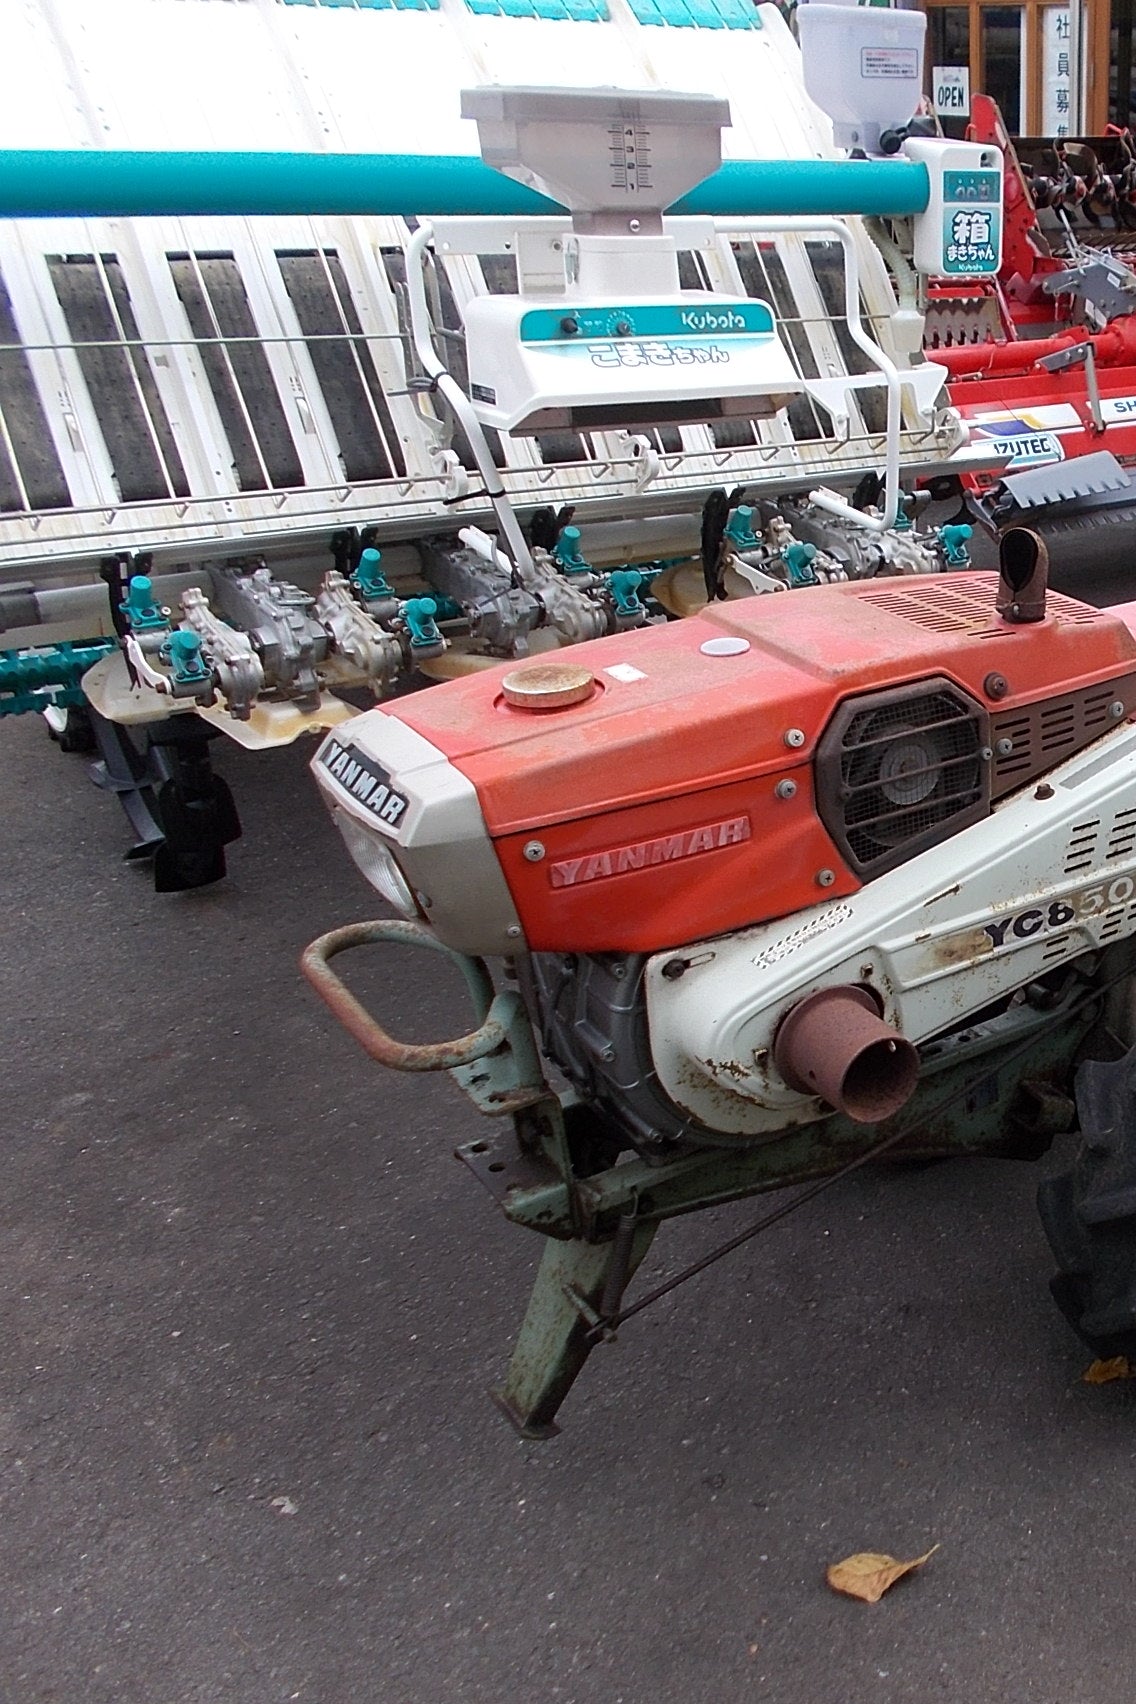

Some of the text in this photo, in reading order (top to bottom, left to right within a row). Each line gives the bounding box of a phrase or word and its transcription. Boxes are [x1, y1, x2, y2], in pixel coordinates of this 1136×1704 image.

[937, 86, 965, 108] OPEN
[952, 211, 991, 244] 箱
[947, 244, 995, 261] まきちゃん
[682, 310, 746, 330] Kubota
[588, 341, 730, 368] こまきちゃん
[324, 742, 406, 824] YANMAR
[554, 819, 746, 885] YANMAR
[985, 876, 1134, 948] YC850
